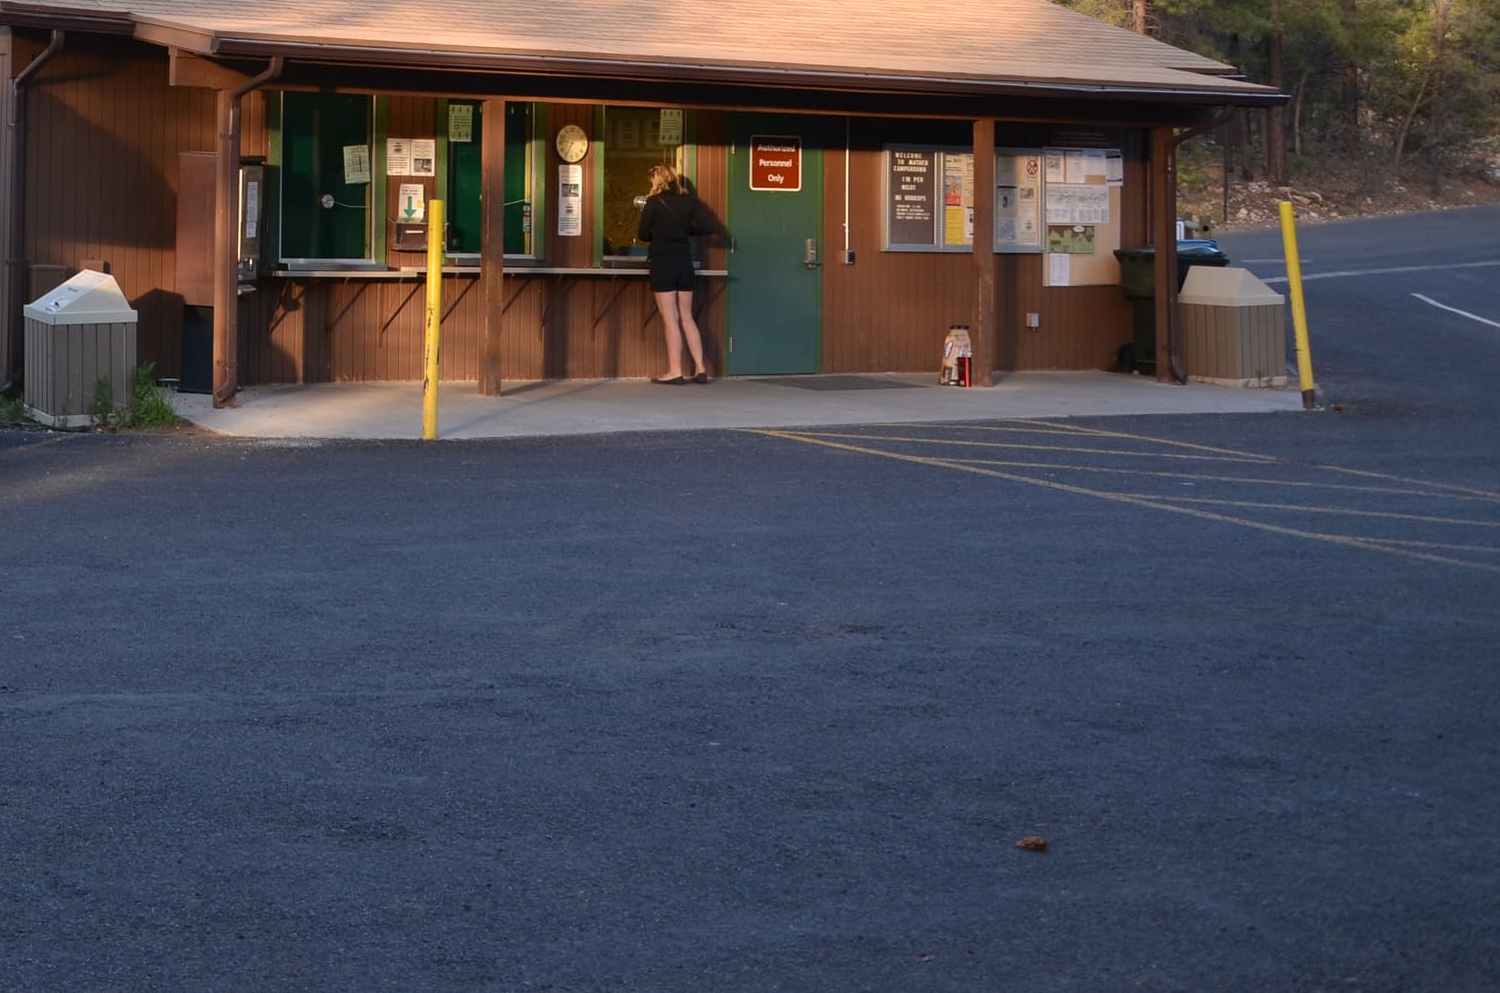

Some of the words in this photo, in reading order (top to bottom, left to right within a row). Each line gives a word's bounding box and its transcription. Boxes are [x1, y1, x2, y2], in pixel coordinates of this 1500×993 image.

[757, 143, 796, 152] Authorized
[759, 159, 792, 167] Personnel
[767, 173, 785, 184] Only
